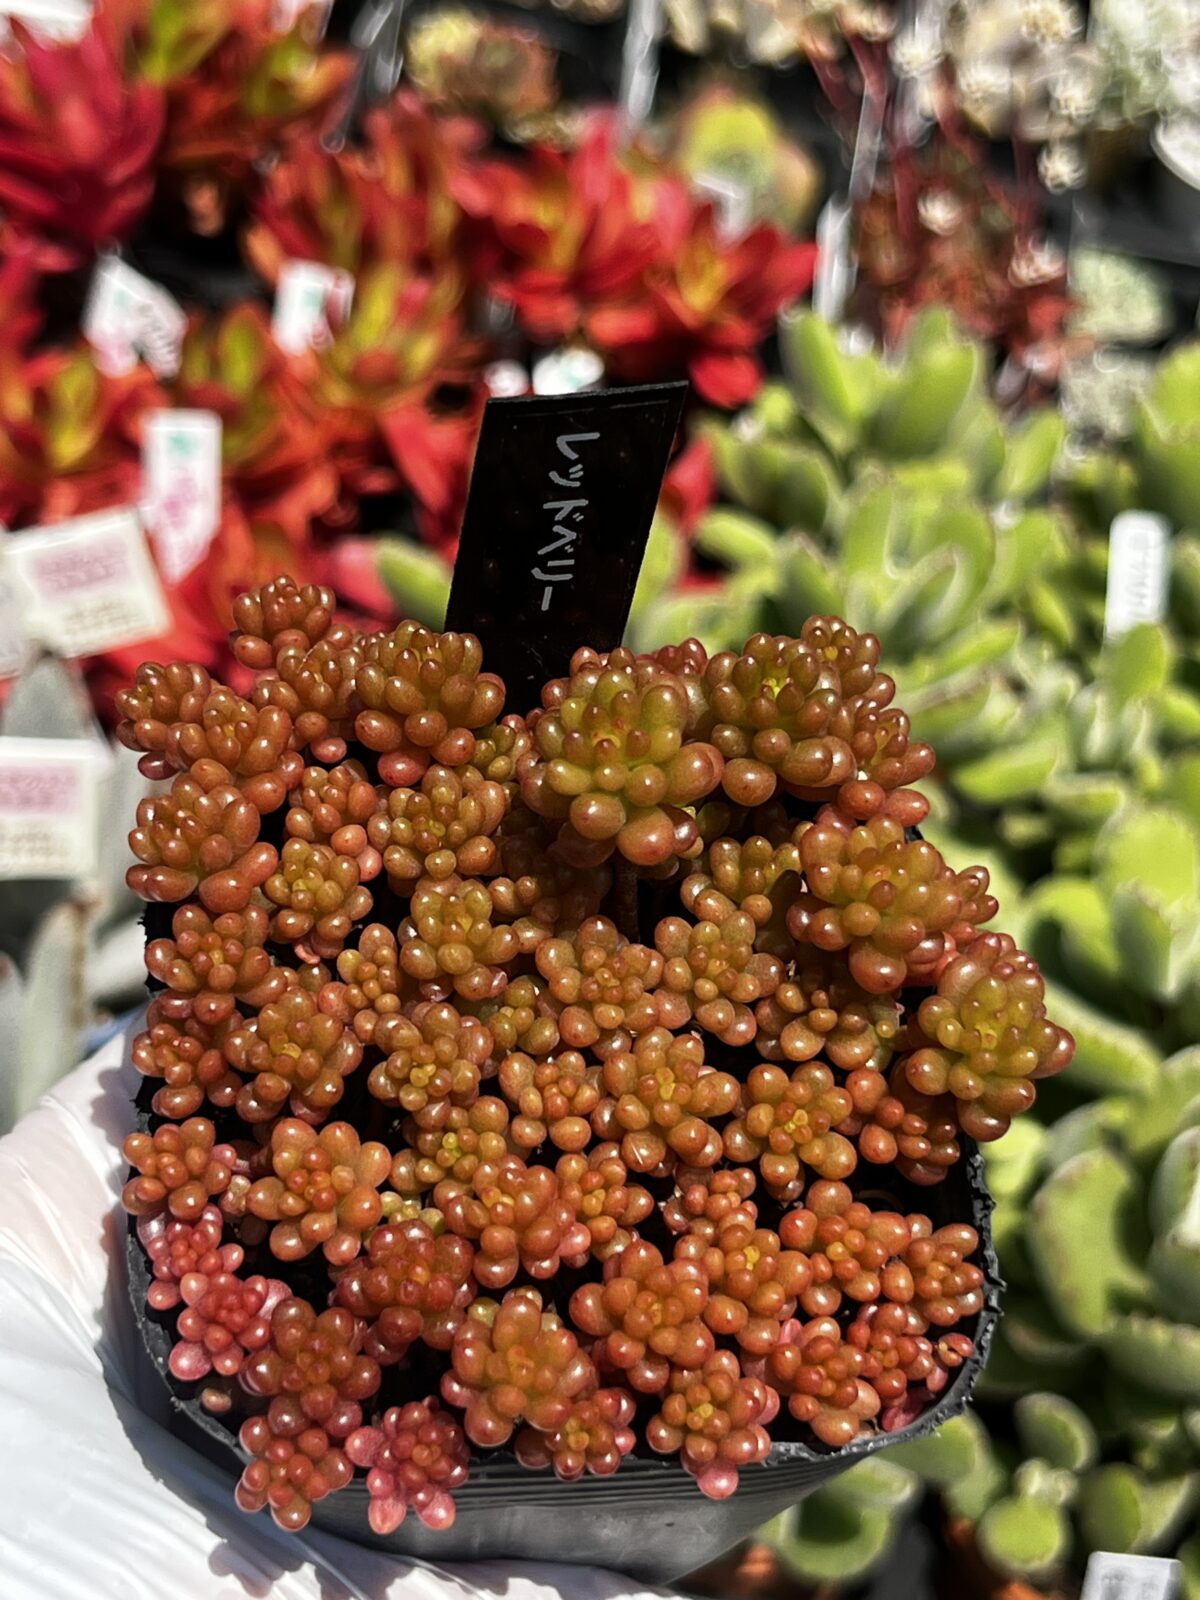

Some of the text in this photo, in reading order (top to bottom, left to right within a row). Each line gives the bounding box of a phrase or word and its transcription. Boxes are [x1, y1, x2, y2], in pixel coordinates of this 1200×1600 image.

[531, 432, 600, 611] レッドベリー
